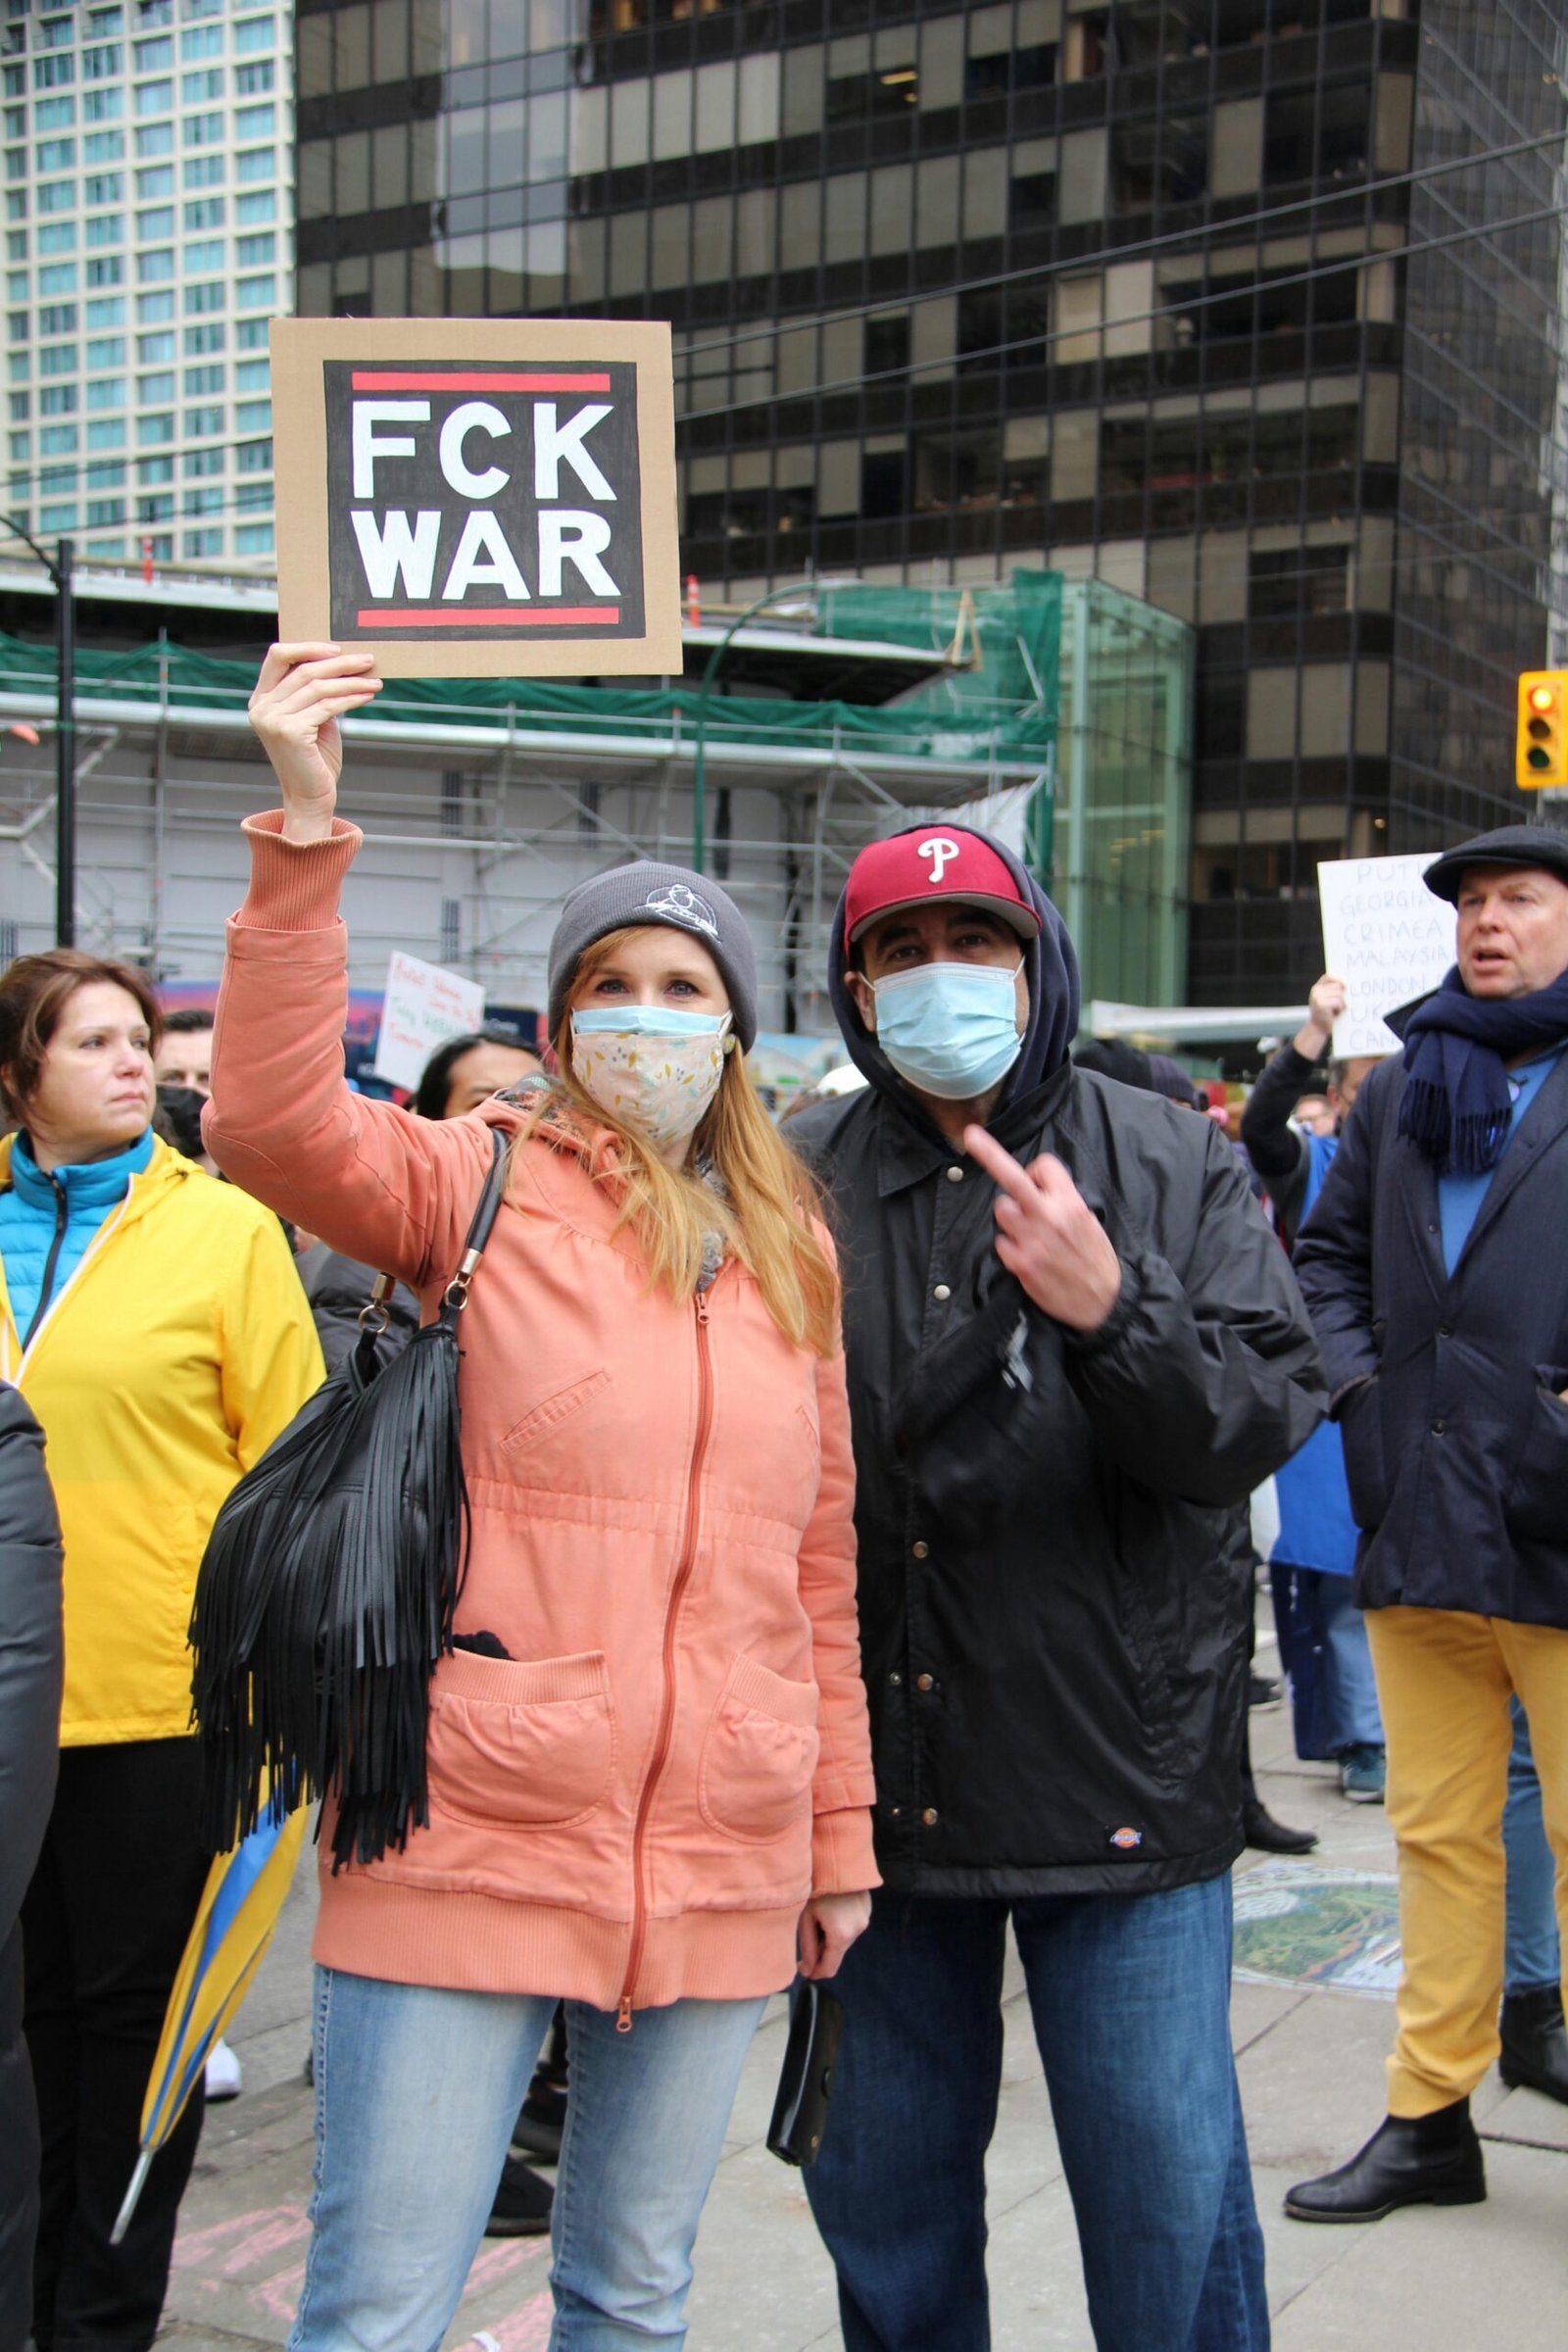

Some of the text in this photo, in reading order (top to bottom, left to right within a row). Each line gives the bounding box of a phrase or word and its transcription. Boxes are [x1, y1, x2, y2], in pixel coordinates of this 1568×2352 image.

[352, 400, 617, 501] FCK
[350, 510, 622, 601] WAR
[917, 838, 959, 883] P
[1340, 889, 1435, 916] GEORGIA
[1344, 918, 1445, 945] CRIMEA
[1349, 973, 1427, 997] LONDON
